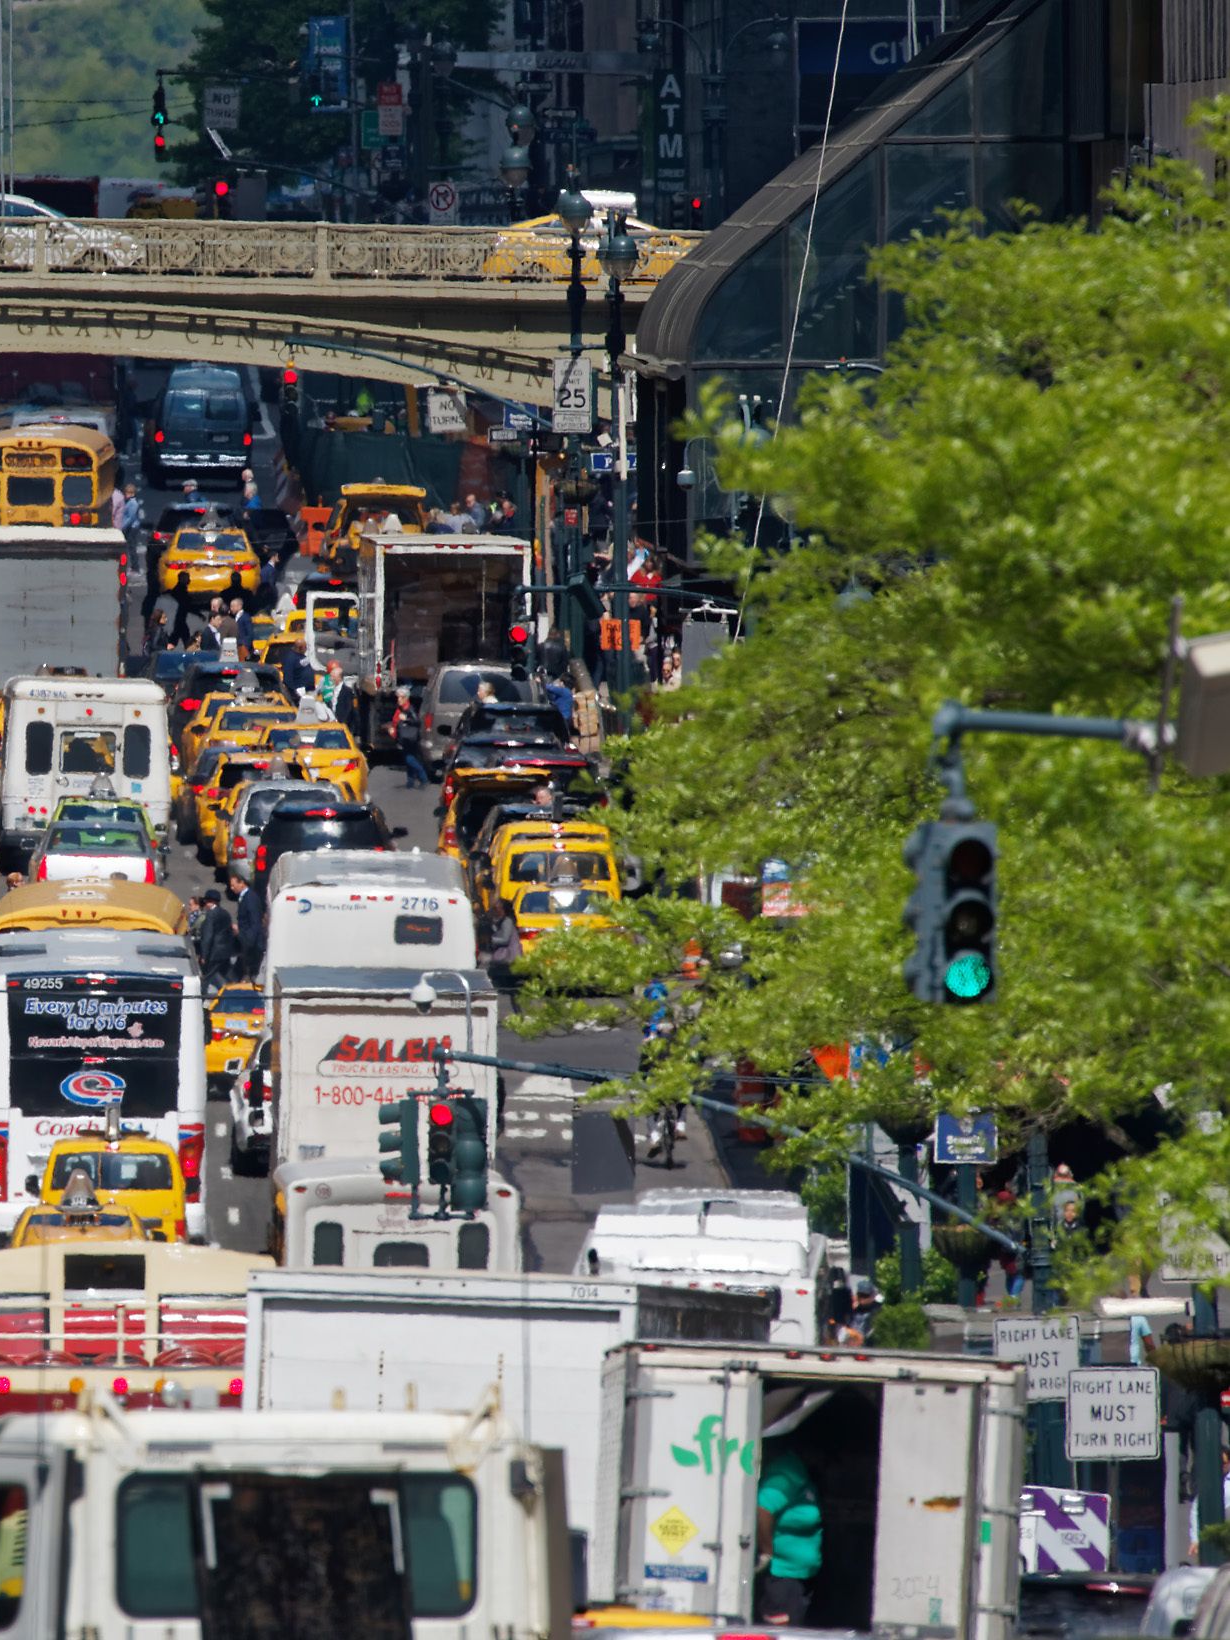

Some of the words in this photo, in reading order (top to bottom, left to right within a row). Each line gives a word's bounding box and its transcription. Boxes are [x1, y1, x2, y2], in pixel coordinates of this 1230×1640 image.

[659, 74, 684, 159] ATM
[16, 316, 155, 341] GRAND
[439, 400, 454, 410] NO
[559, 388, 586, 408] 25
[432, 415, 464, 426] TURNS
[401, 897, 439, 912] 2716
[23, 978, 64, 990] 49255
[24, 998, 75, 1018] Every
[77, 999, 98, 1015] 15
[98, 997, 168, 1015] minutes
[67, 1014, 92, 1030] for
[94, 1015, 127, 1031] $16
[331, 1063, 368, 1073] TRUCK
[35, 1120, 100, 1136] Coach
[1000, 1328, 1036, 1343] RIGHT
[1027, 1351, 1061, 1368] UST
[1073, 1380, 1112, 1394] RIGHT
[1119, 1381, 1153, 1394] LANE
[1090, 1405, 1136, 1422] MUST
[1074, 1433, 1107, 1446] TURN
[1114, 1433, 1154, 1446] RIGHT
